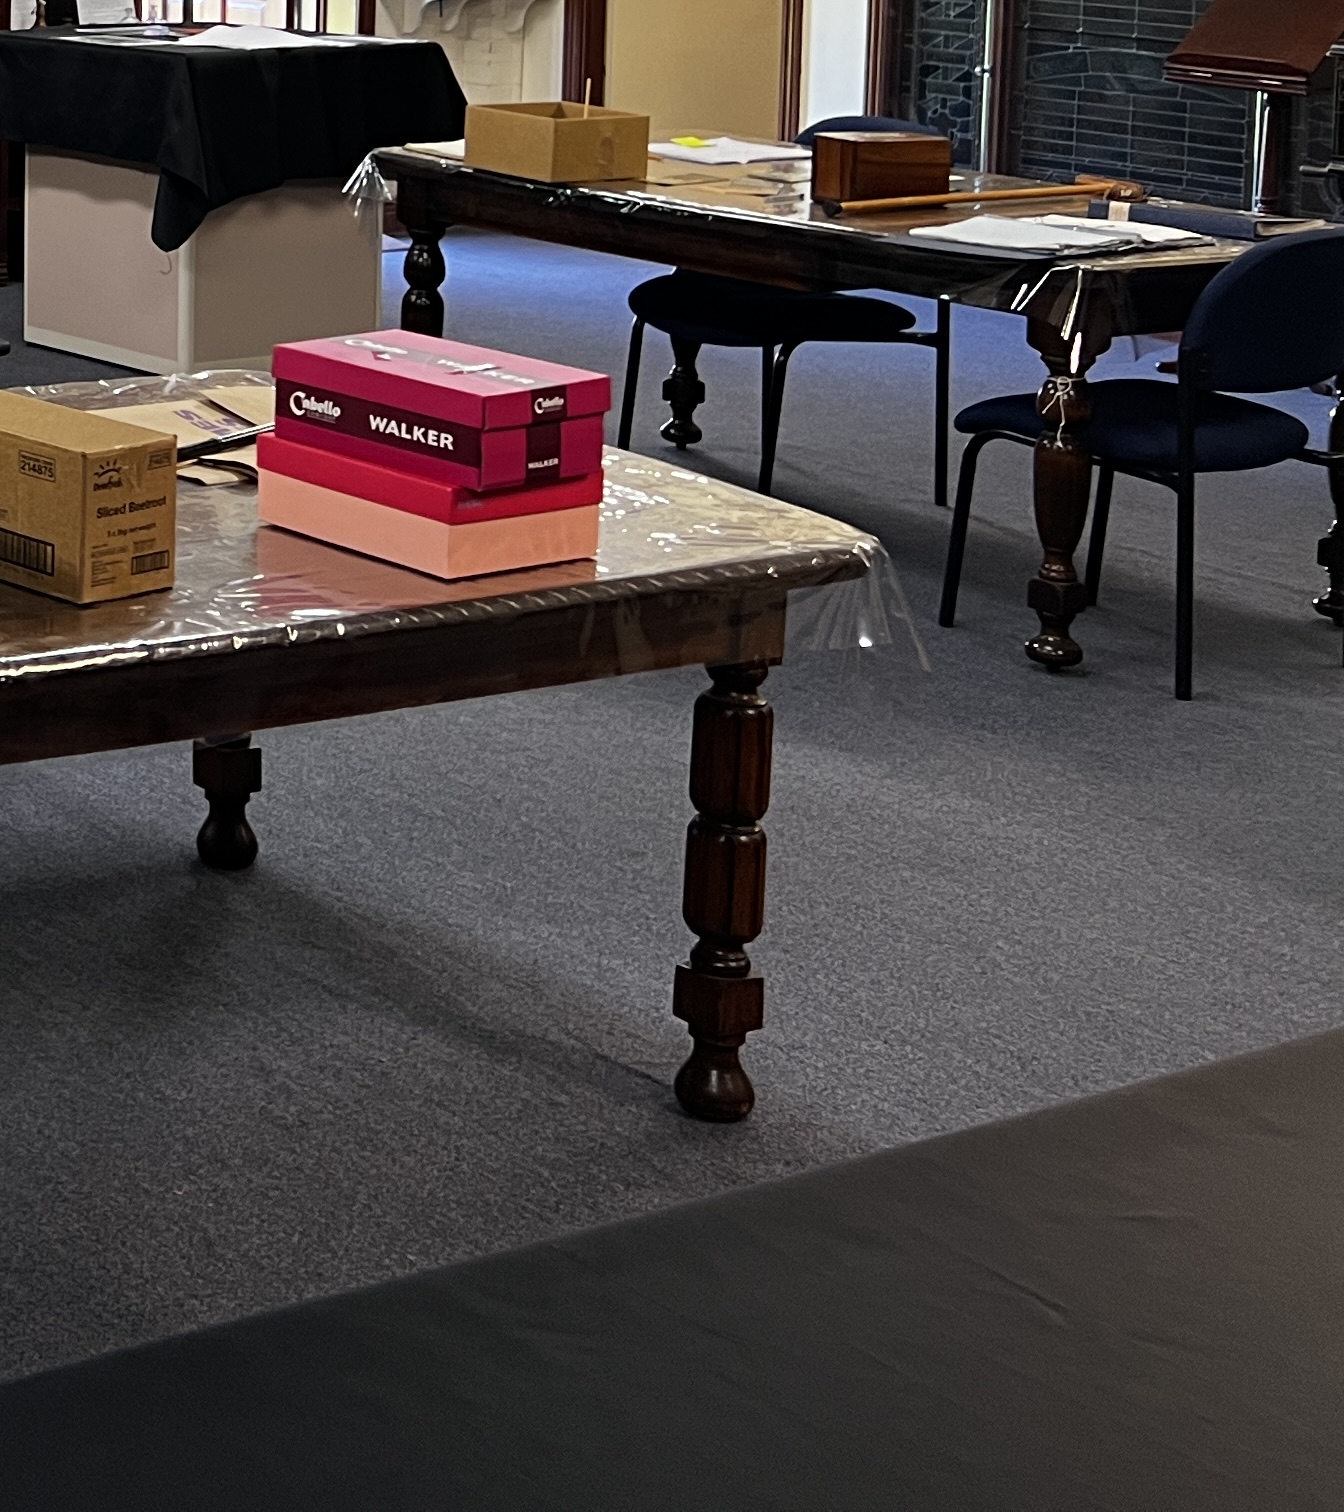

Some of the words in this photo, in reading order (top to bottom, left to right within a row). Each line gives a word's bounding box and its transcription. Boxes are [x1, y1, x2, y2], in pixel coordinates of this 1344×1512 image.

[289, 391, 341, 416] Cabello
[534, 396, 564, 414] Cabello
[369, 414, 454, 451] WALKER
[20, 459, 54, 478] 214875
[528, 458, 559, 469] WALKER
[96, 503, 126, 519] Sliced
[128, 495, 166, 513] Beetroot
